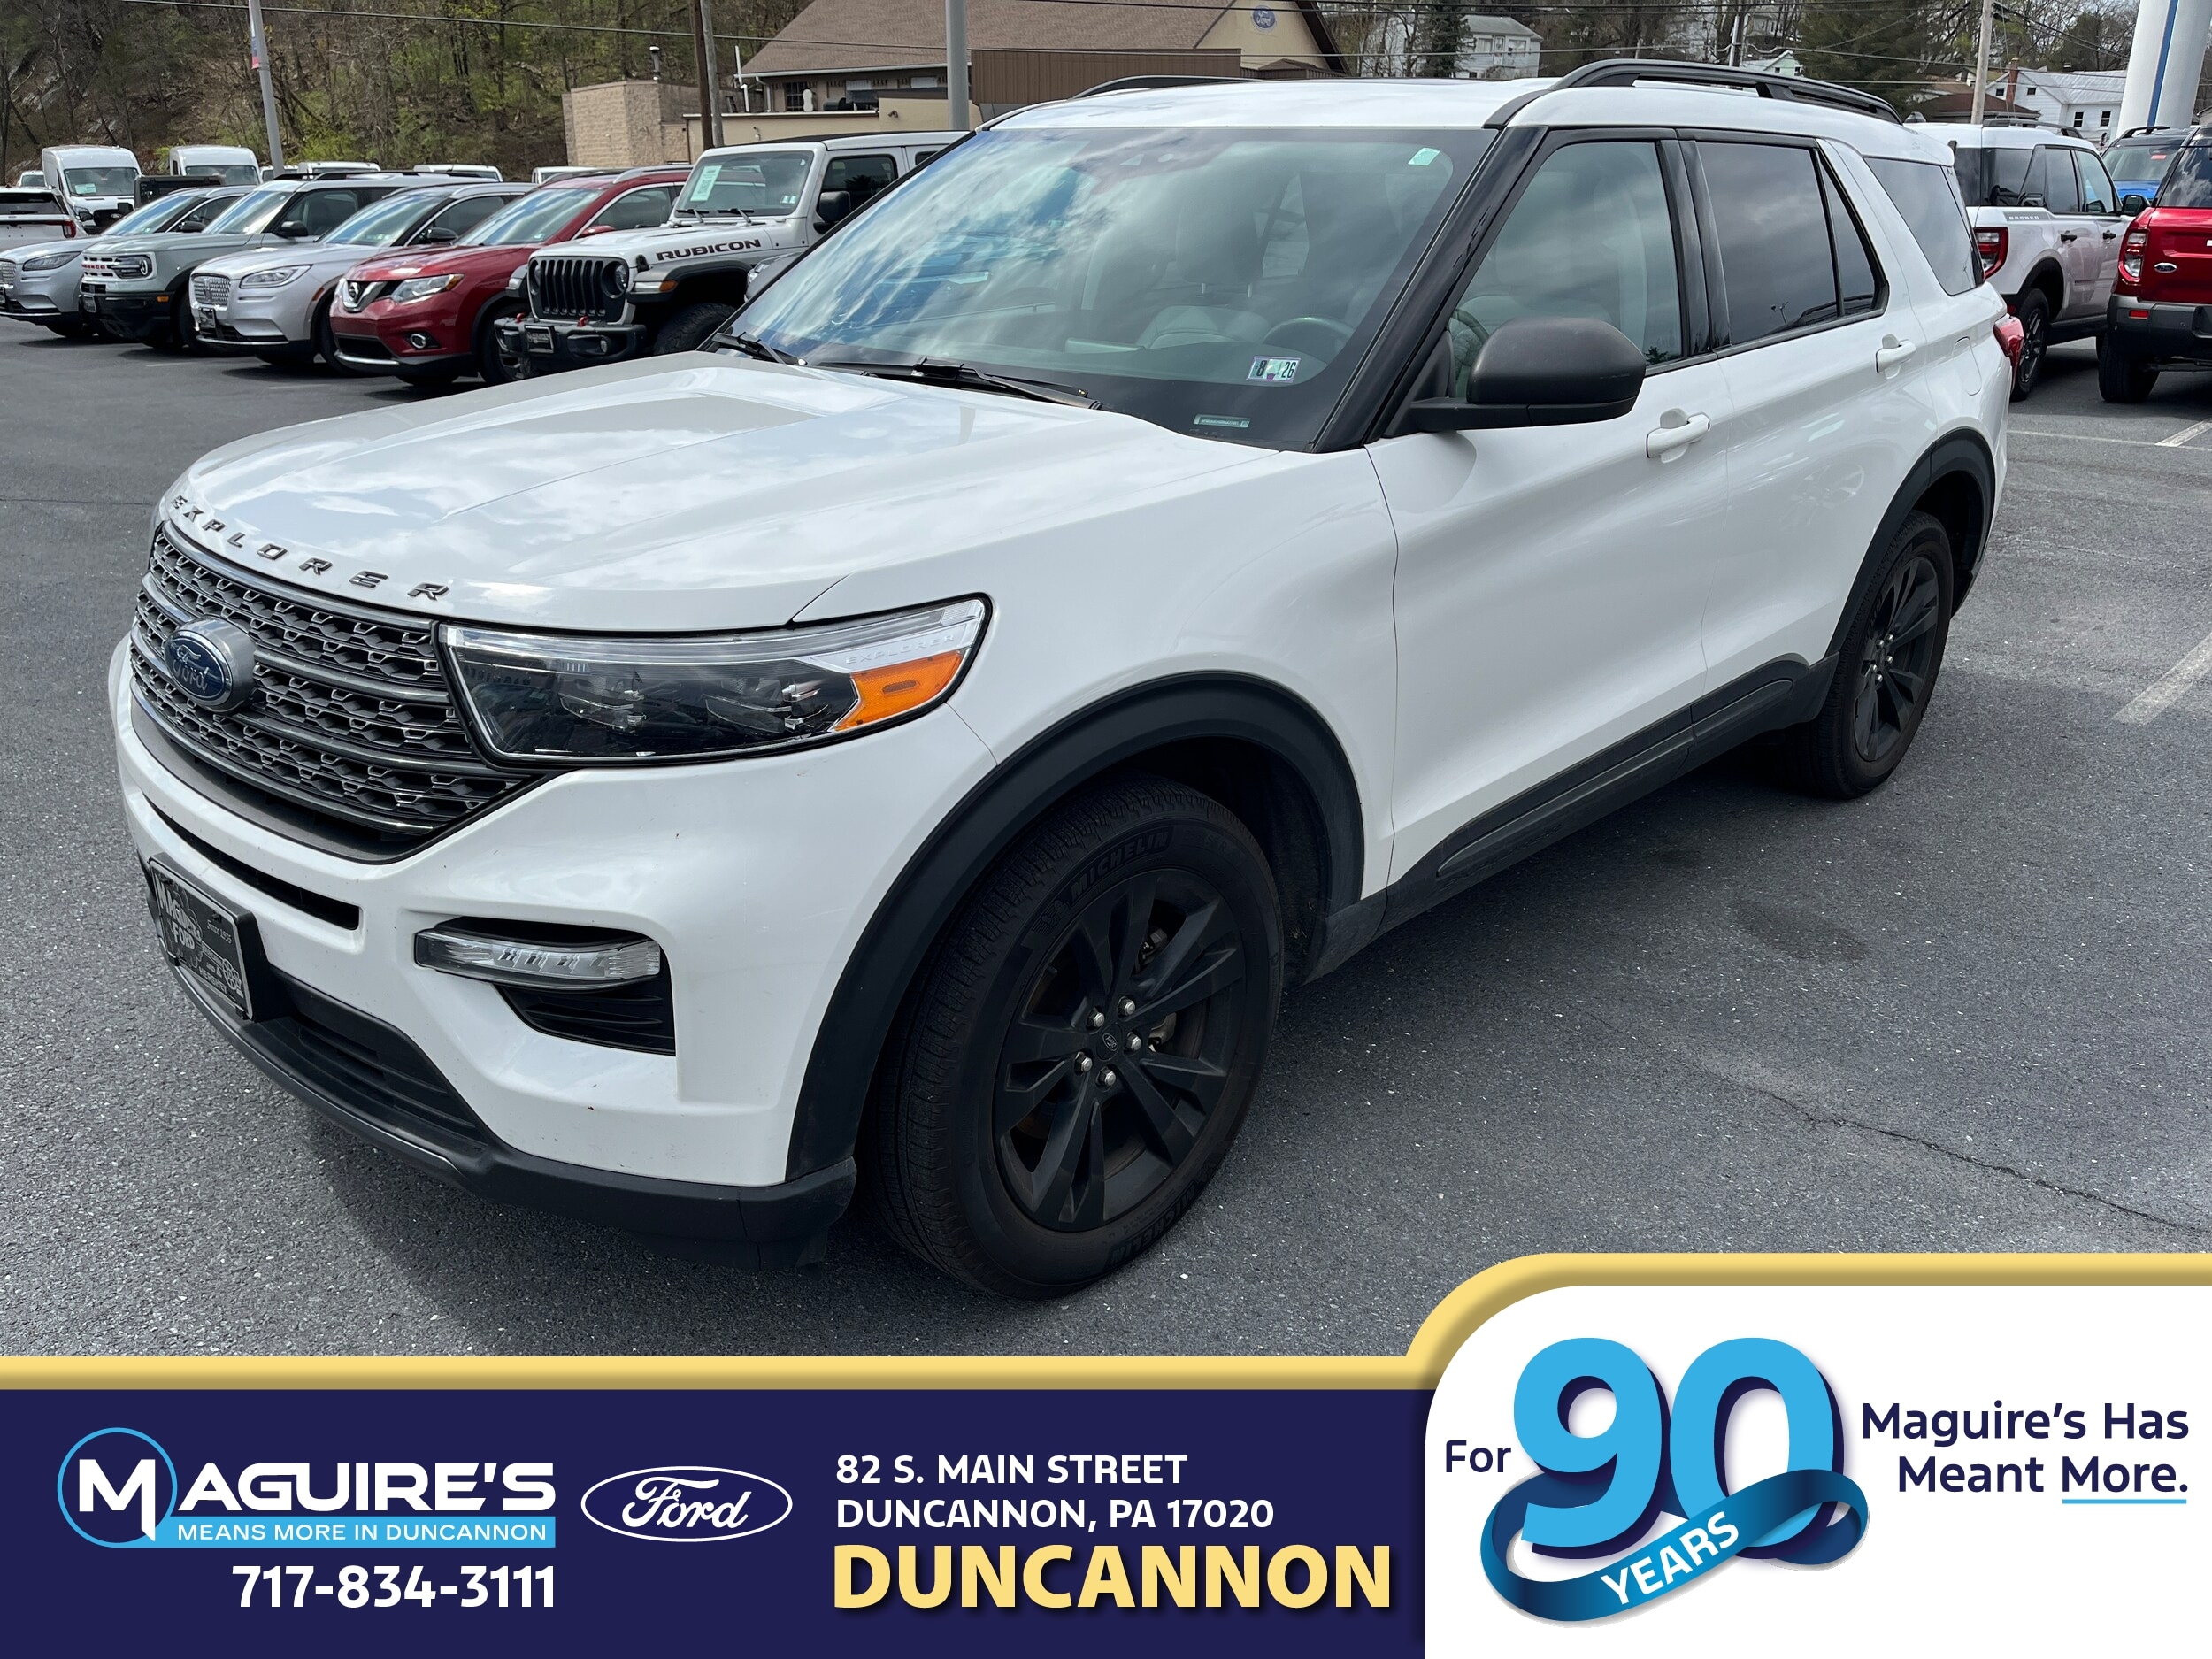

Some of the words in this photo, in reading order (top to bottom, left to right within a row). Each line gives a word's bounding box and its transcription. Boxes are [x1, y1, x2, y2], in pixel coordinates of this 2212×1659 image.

[656, 239, 762, 261] RUBICON
[1281, 361, 1296, 378] 26
[171, 495, 450, 602] EXPLORER
[173, 644, 211, 694] Ford
[1071, 831, 1170, 901] MICHELIN
[173, 923, 196, 951] FORD
